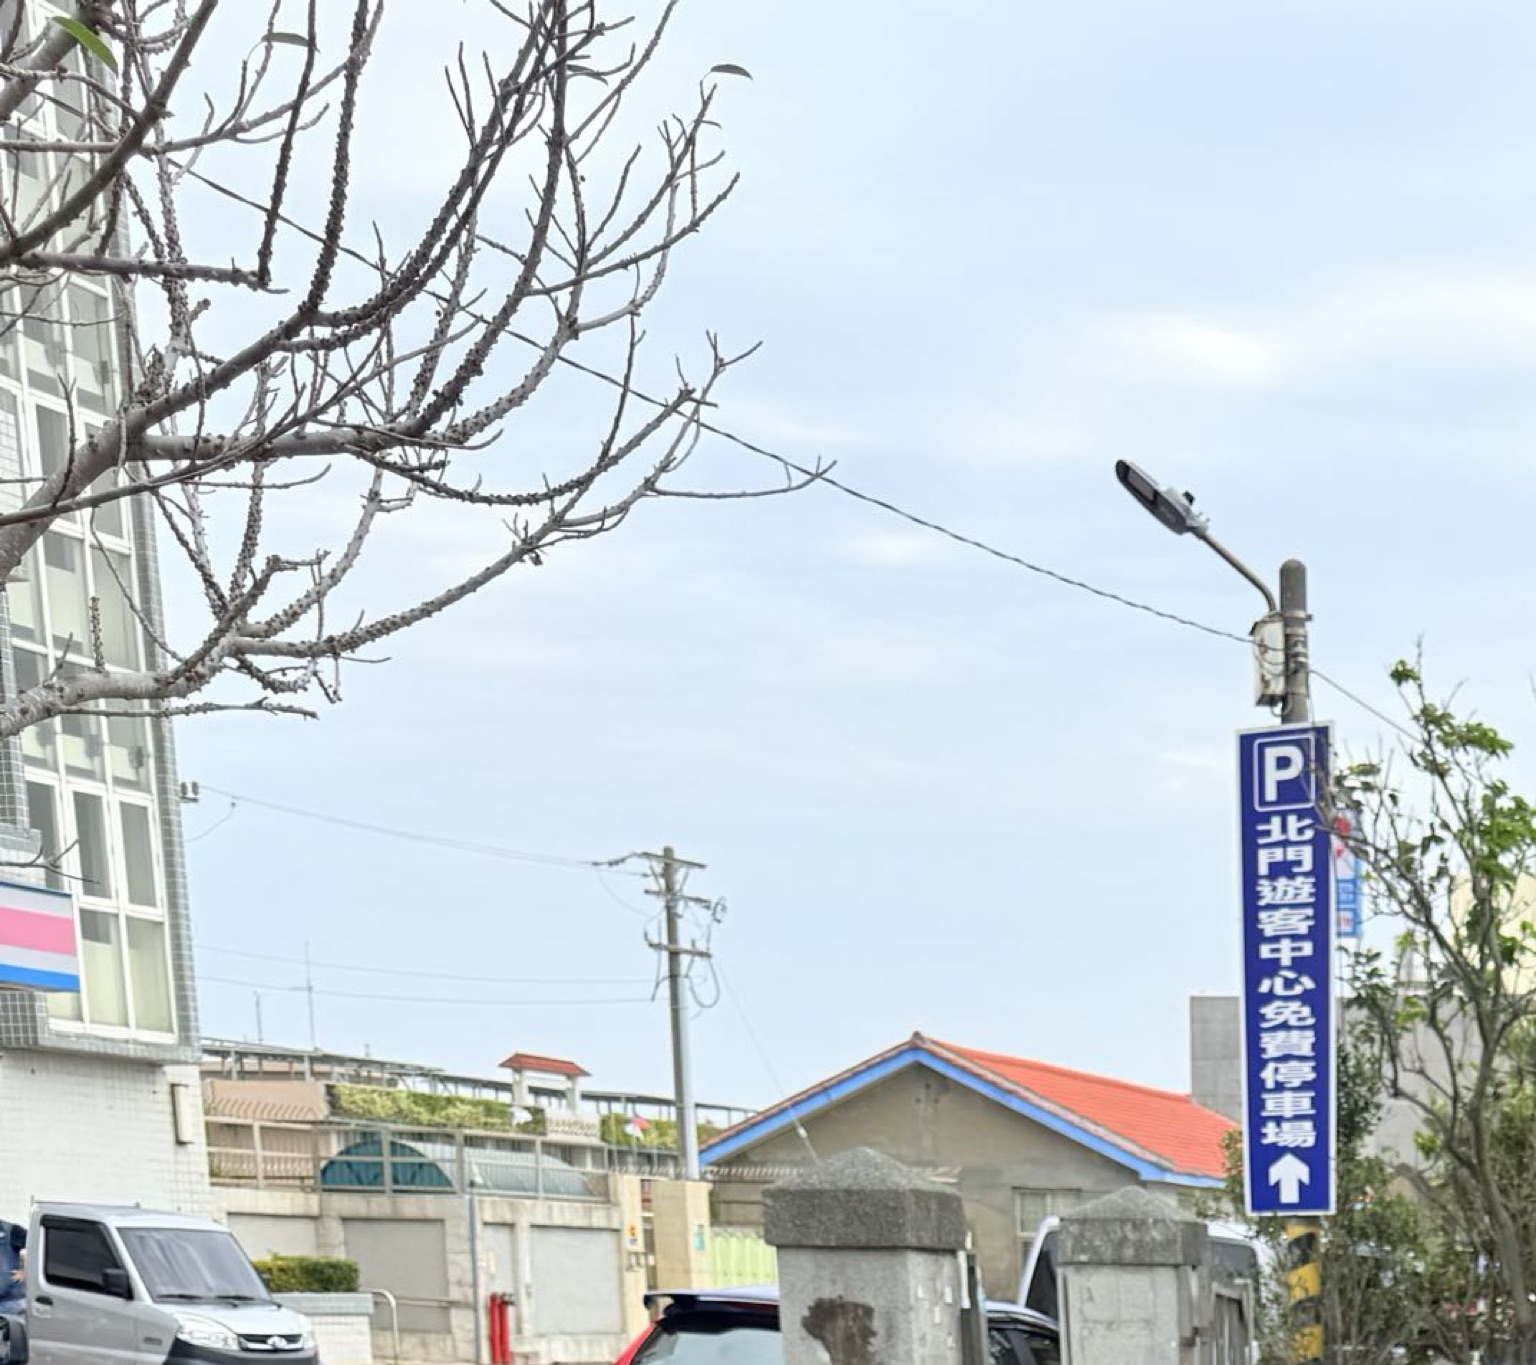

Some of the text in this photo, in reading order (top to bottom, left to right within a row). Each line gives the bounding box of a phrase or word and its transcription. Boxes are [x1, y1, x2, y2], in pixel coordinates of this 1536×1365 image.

[1263, 745, 1304, 803] P
[1256, 814, 1317, 1149] 北門遊客中心免費停車場
